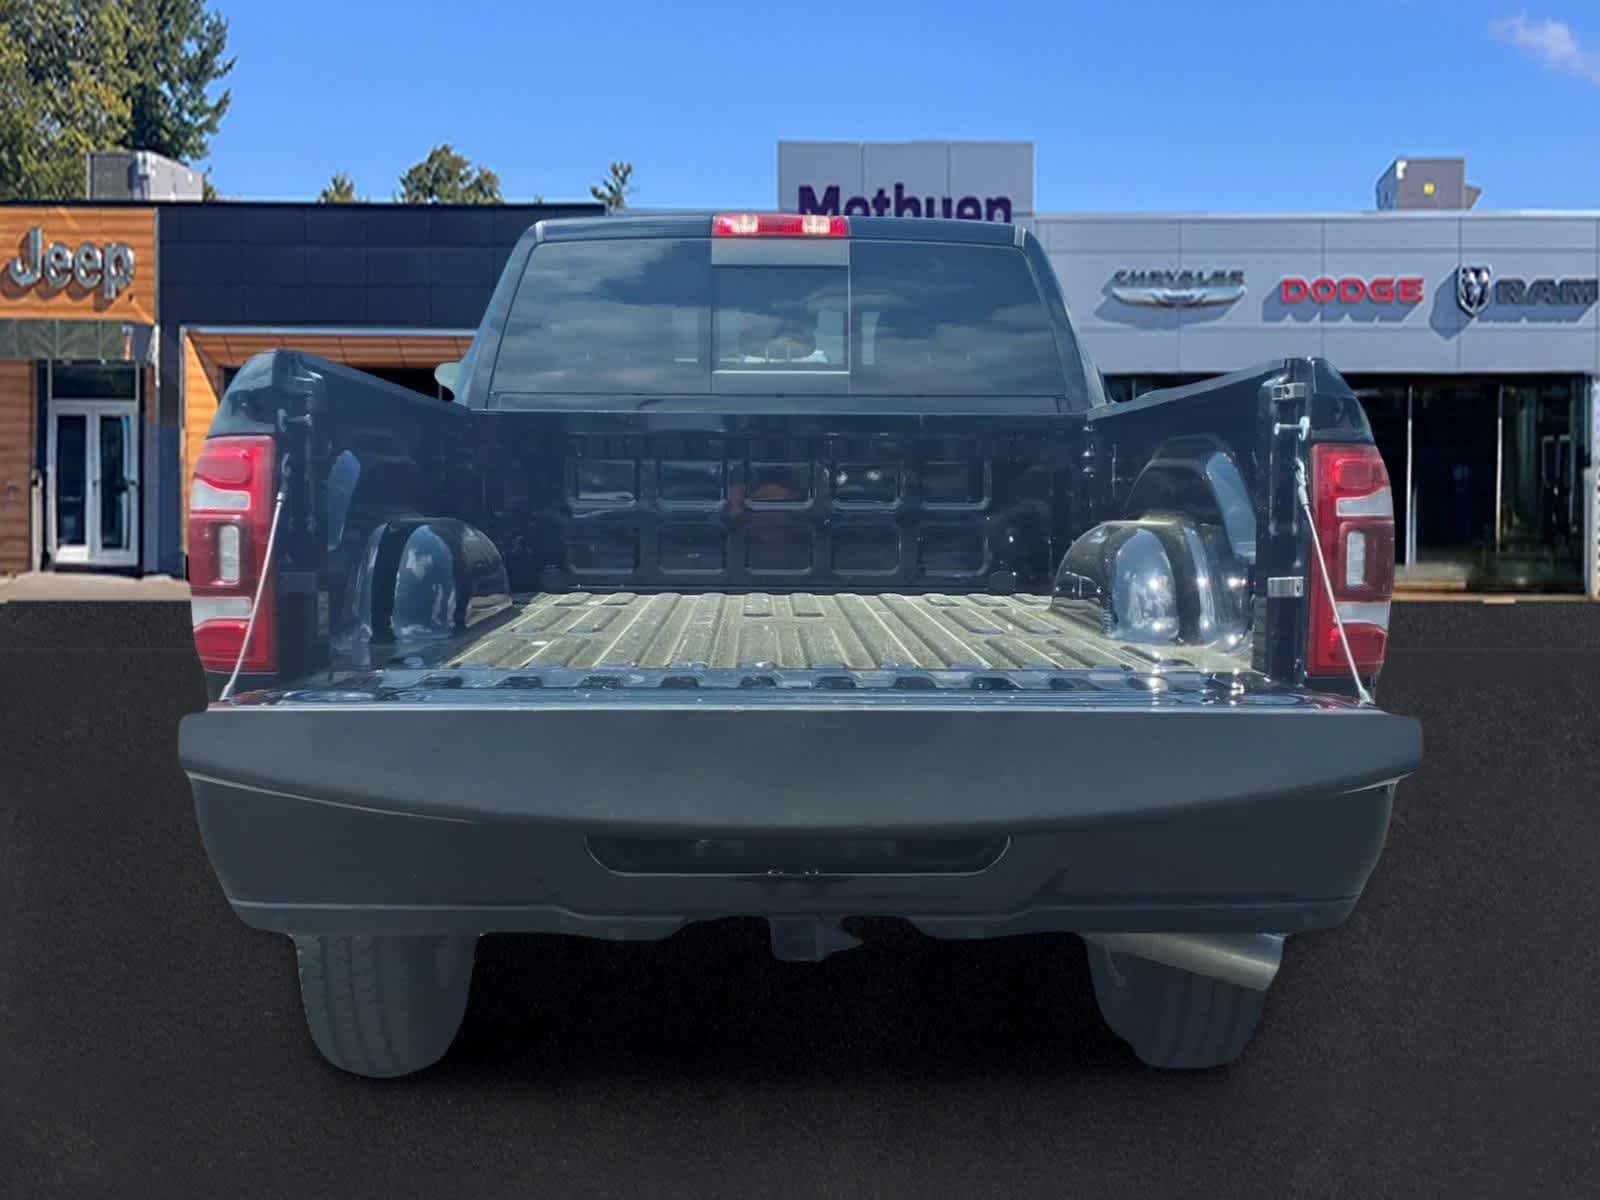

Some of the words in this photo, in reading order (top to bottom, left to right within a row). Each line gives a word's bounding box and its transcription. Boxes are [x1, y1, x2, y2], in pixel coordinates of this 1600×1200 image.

[9, 227, 135, 299] Jeep
[1114, 270, 1244, 286] CHRYSLER
[1282, 278, 1423, 302] DODGE
[1496, 279, 1599, 304] RAM
